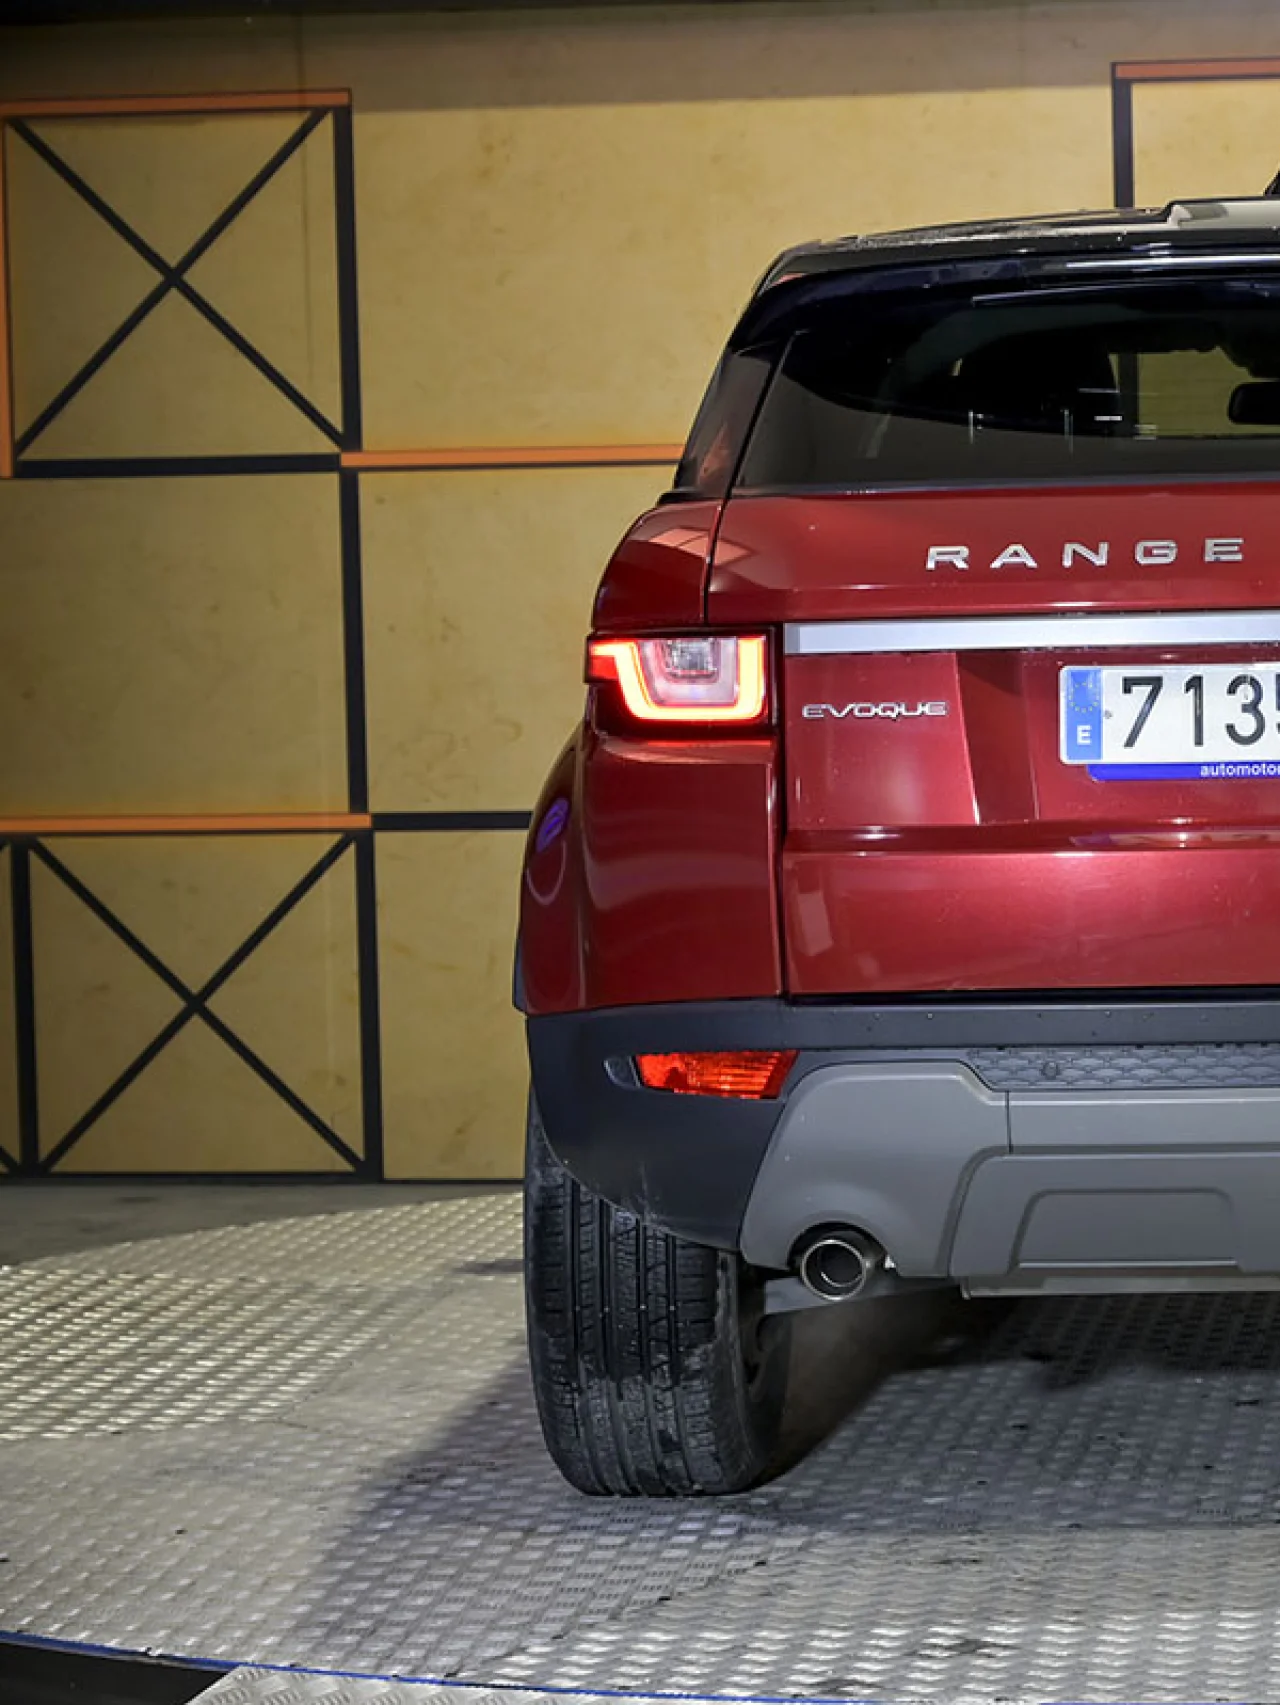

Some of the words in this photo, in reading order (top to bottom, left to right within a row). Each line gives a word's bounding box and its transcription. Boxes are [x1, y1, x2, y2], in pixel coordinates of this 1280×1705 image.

[926, 538, 1245, 570] RANGE
[802, 701, 948, 720] EVOQUE
[1076, 725, 1092, 745] E
